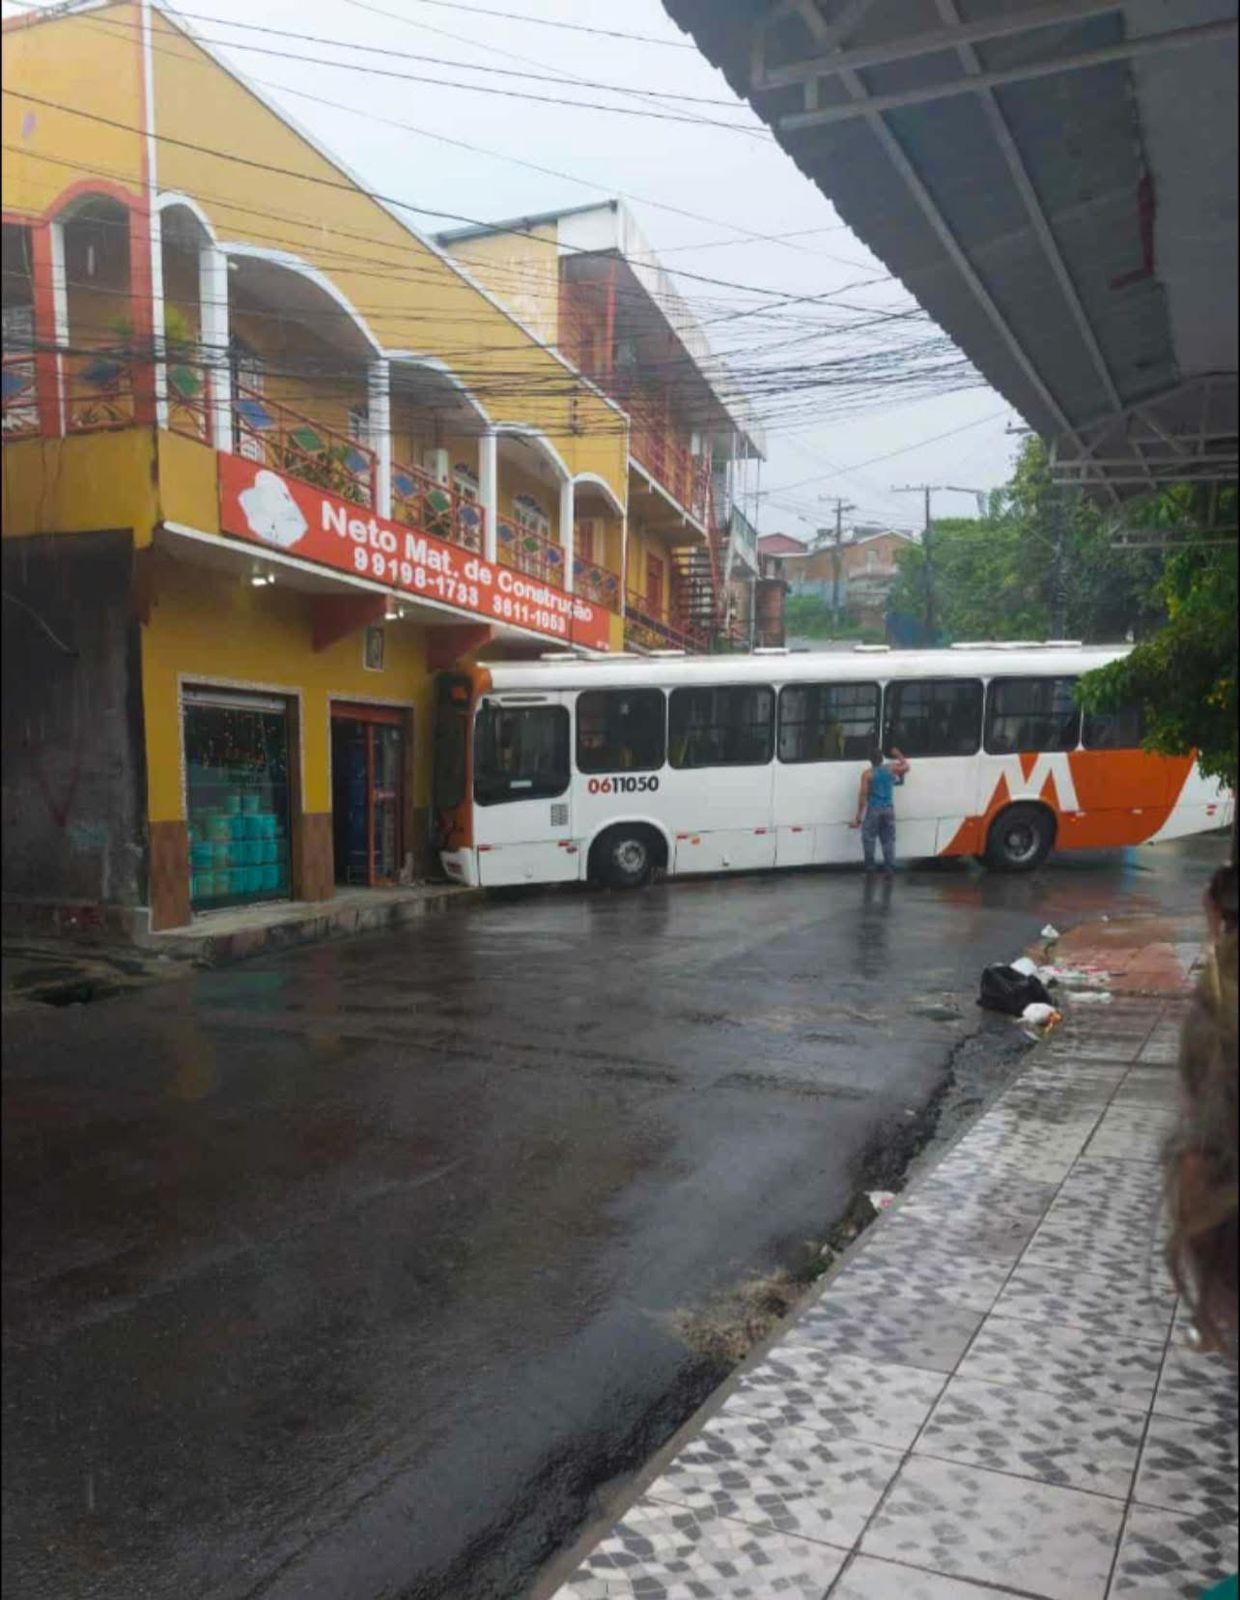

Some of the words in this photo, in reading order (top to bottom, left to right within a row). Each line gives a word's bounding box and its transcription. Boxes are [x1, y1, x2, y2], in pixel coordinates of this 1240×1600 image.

[321, 500, 397, 552] Neto
[405, 533, 459, 579] Mat.
[464, 559, 492, 586] de
[498, 570, 594, 622] Construção
[587, 775, 660, 795] 0611050
